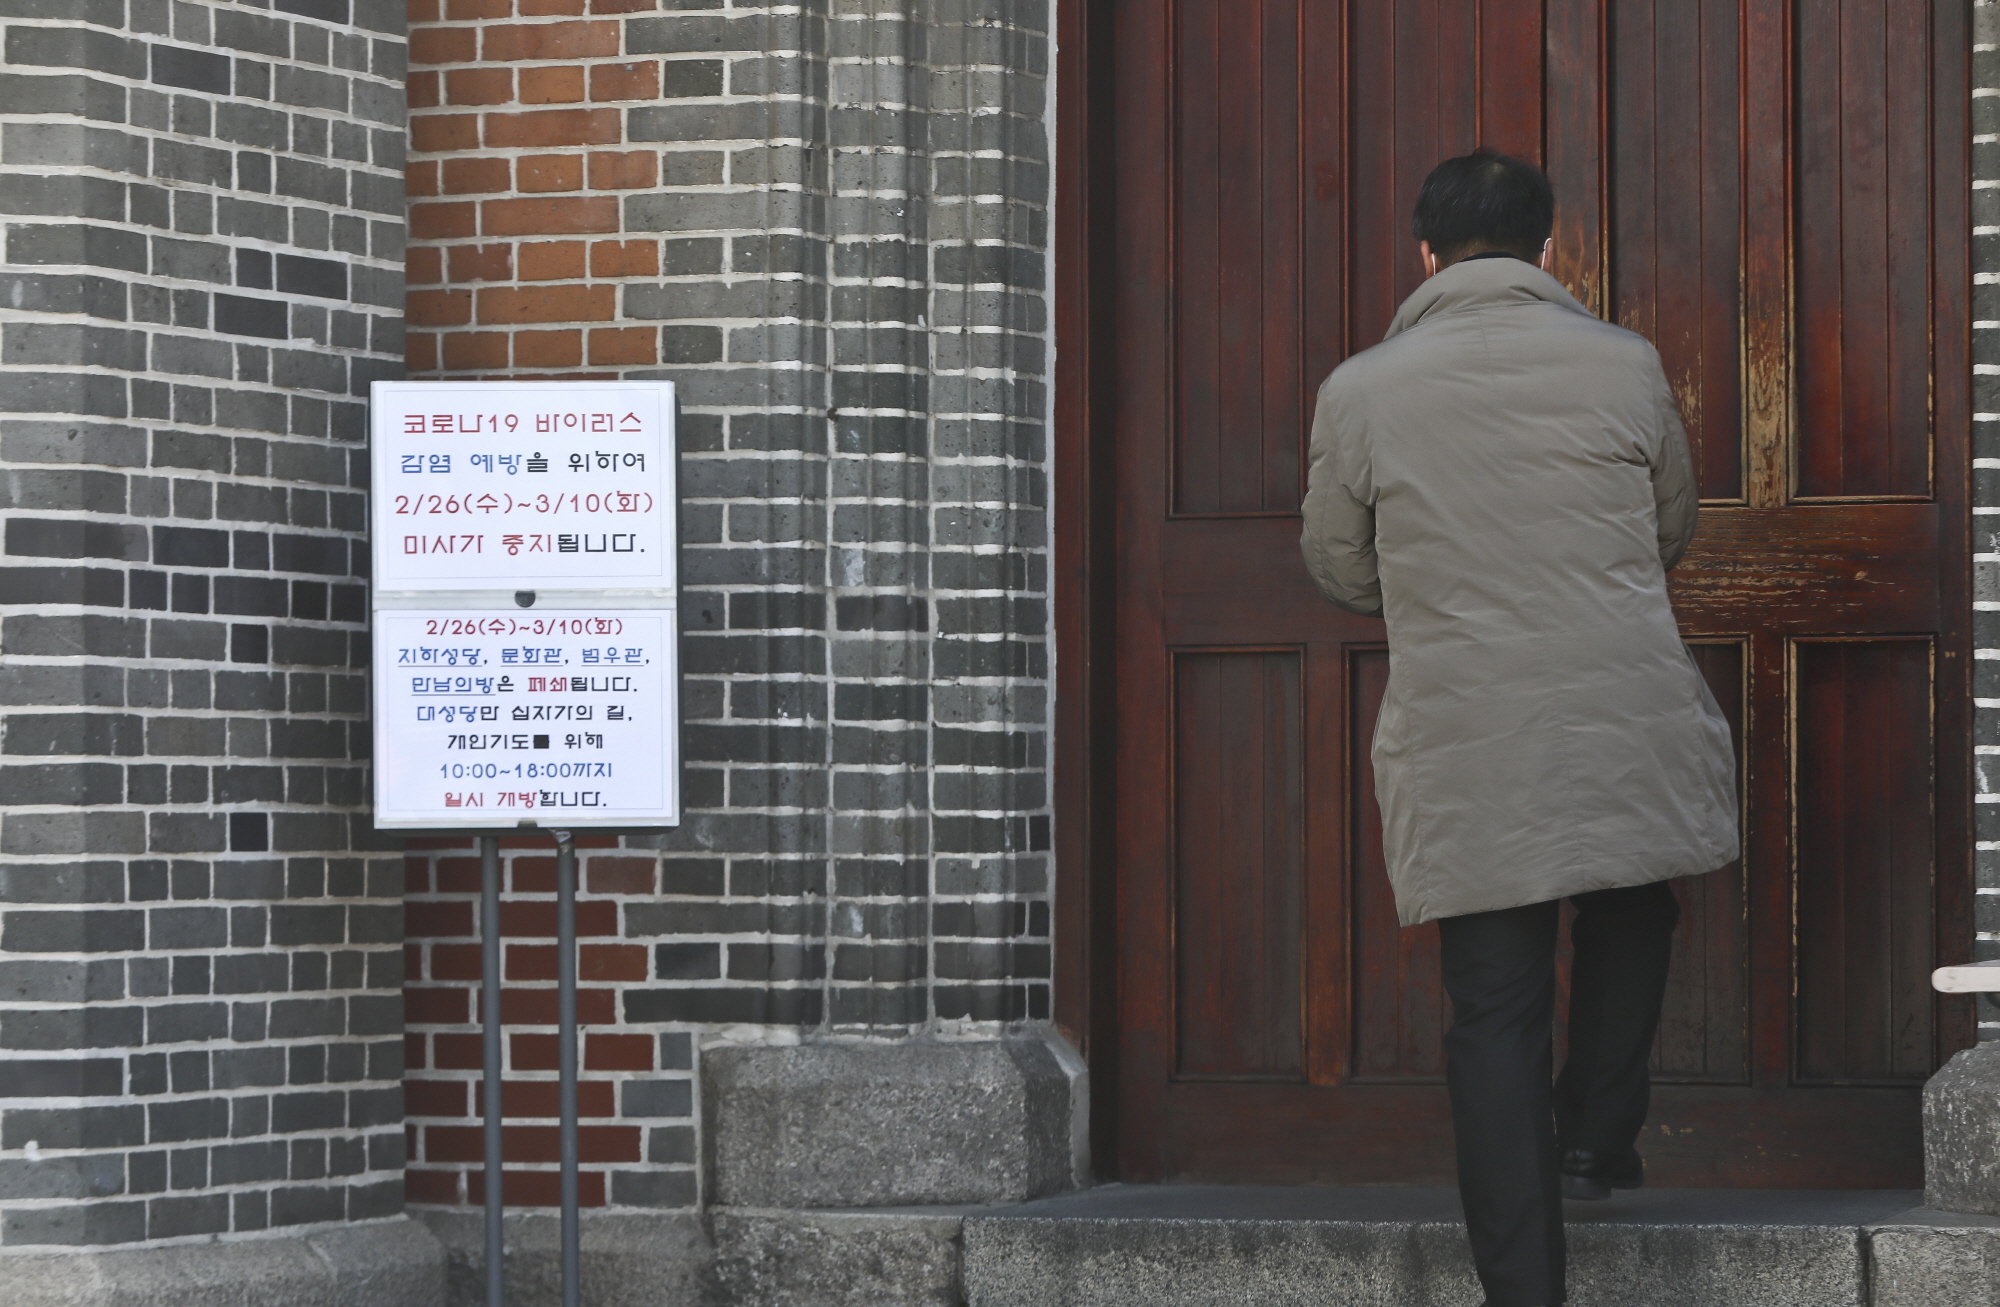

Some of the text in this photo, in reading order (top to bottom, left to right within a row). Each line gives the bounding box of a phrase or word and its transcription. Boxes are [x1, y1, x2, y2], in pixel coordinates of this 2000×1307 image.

[403, 412, 642, 433] 코로나19 바이러스
[401, 451, 645, 475] 감염 예방을 위하여
[395, 491, 653, 515] 2/26(수)~3/10(화)
[404, 533, 645, 556] 미사가 중지됩니다.
[426, 617, 623, 635] 2/26(수)~3/10(화)
[398, 646, 650, 666] 지하성당, 문화관, 범우관,
[412, 676, 638, 694] 만남의방은 폐쇄됩니다.
[417, 705, 633, 723] 대성당만 십자가의 길,
[447, 731, 603, 750] 개인기도 위해
[440, 763, 612, 779] 10:00~18:00까지
[444, 789, 607, 807] 일시 개방합니다.
